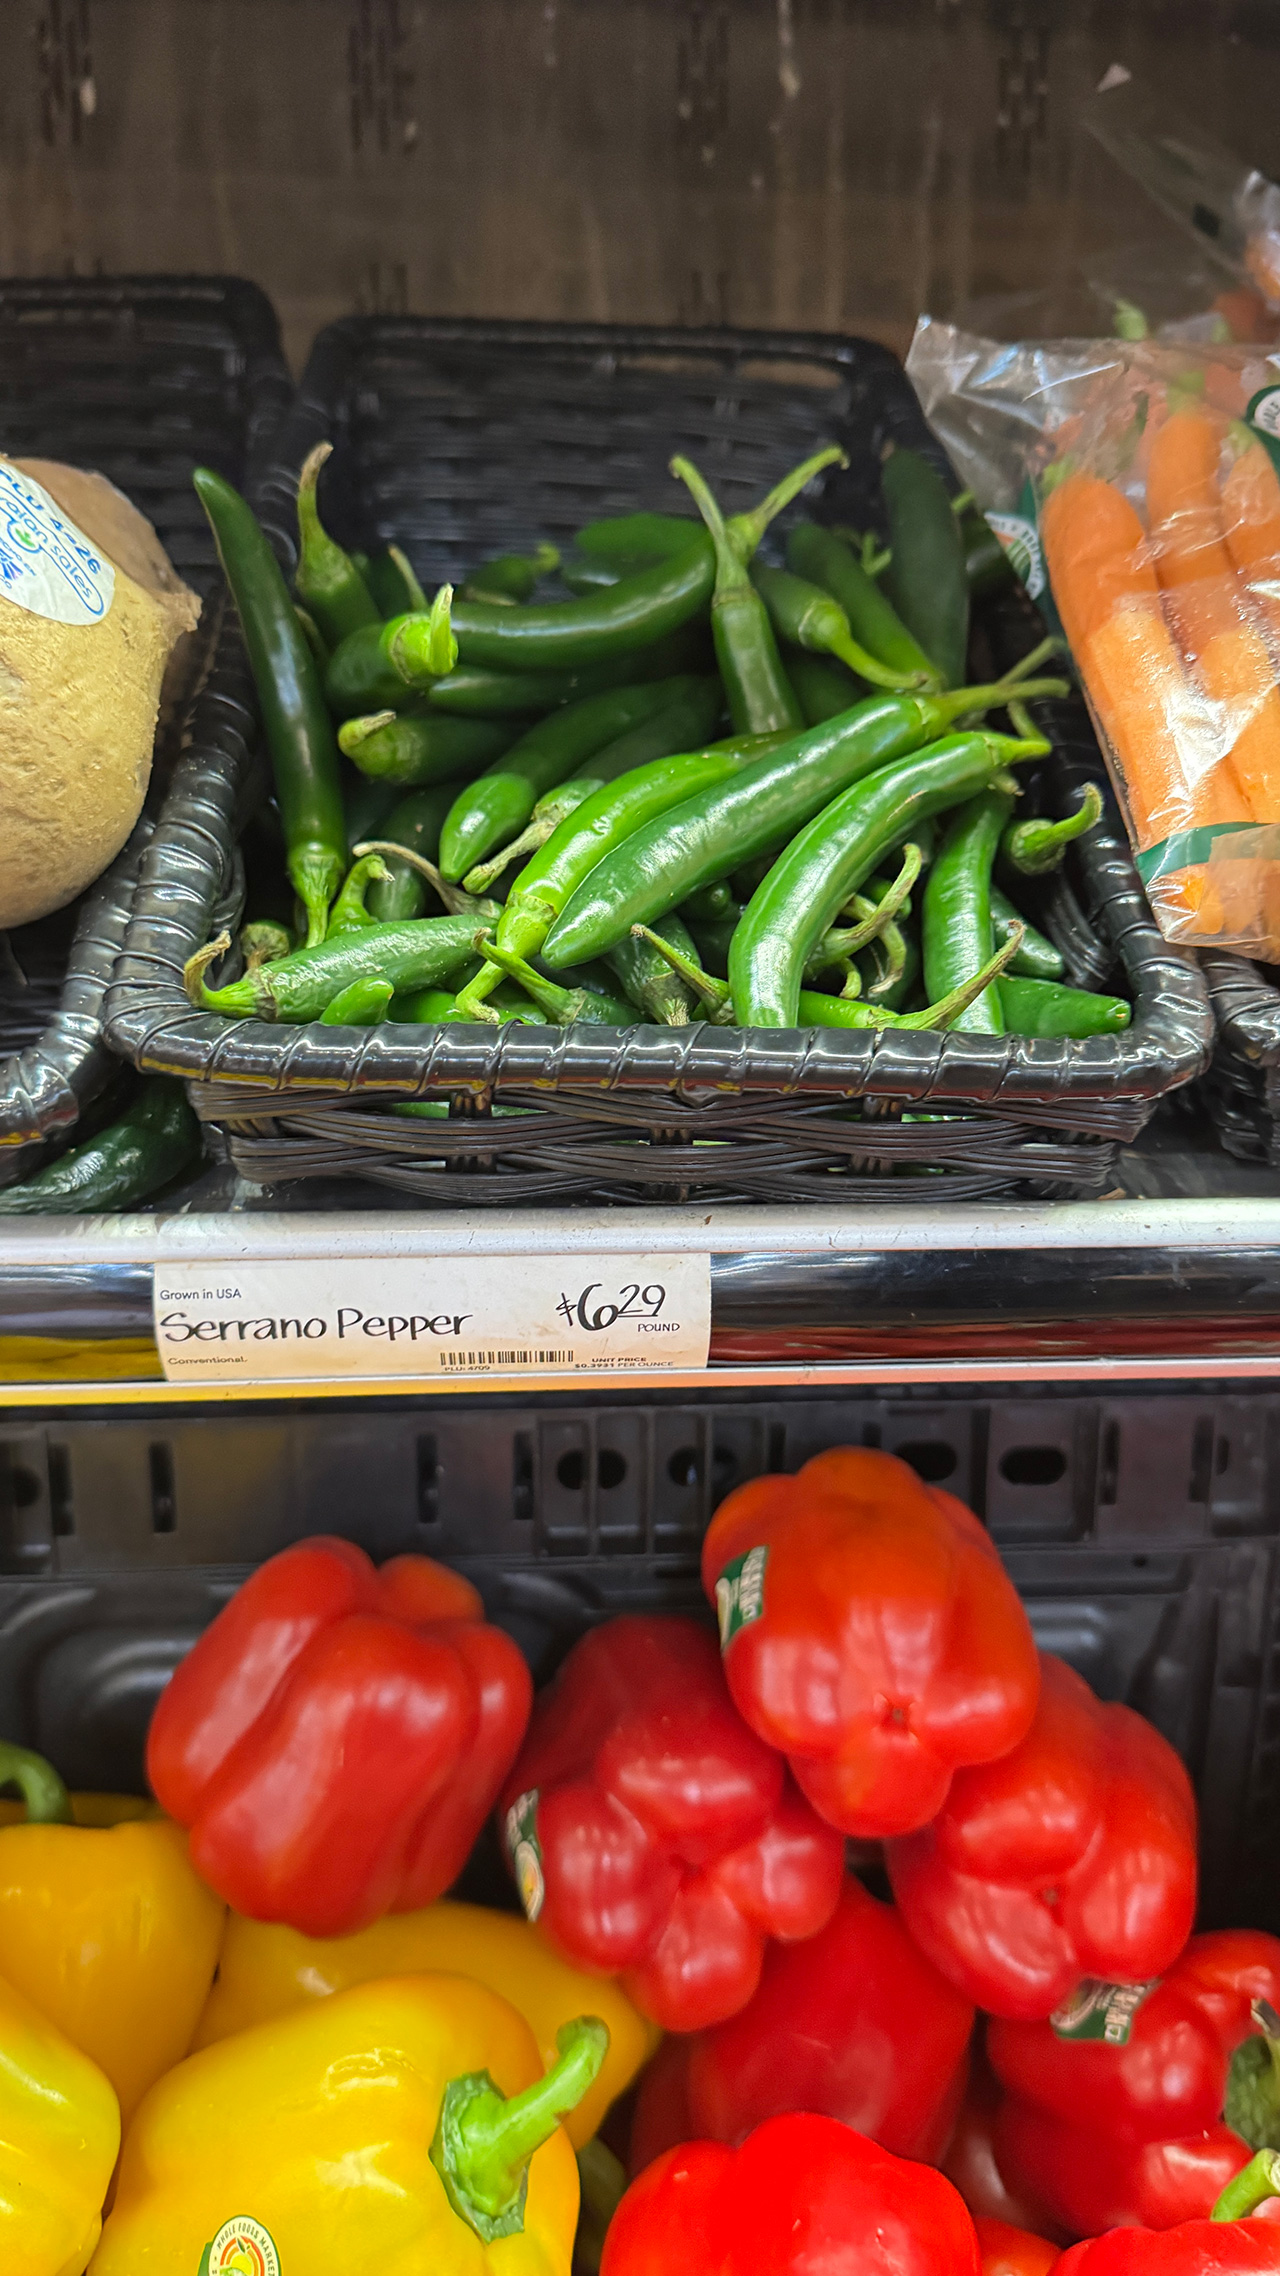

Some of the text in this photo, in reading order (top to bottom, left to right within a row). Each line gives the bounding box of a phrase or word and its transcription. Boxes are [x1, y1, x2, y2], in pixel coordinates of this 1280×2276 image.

[50, 545, 92, 598] sales
[160, 1288, 242, 1300] Grown in USA
[160, 1307, 473, 1342] Serrano Pepper
[637, 1323, 681, 1332] POUND
[217, 2224, 236, 2250] WHOLE
[238, 2222, 259, 2239] FOODS
